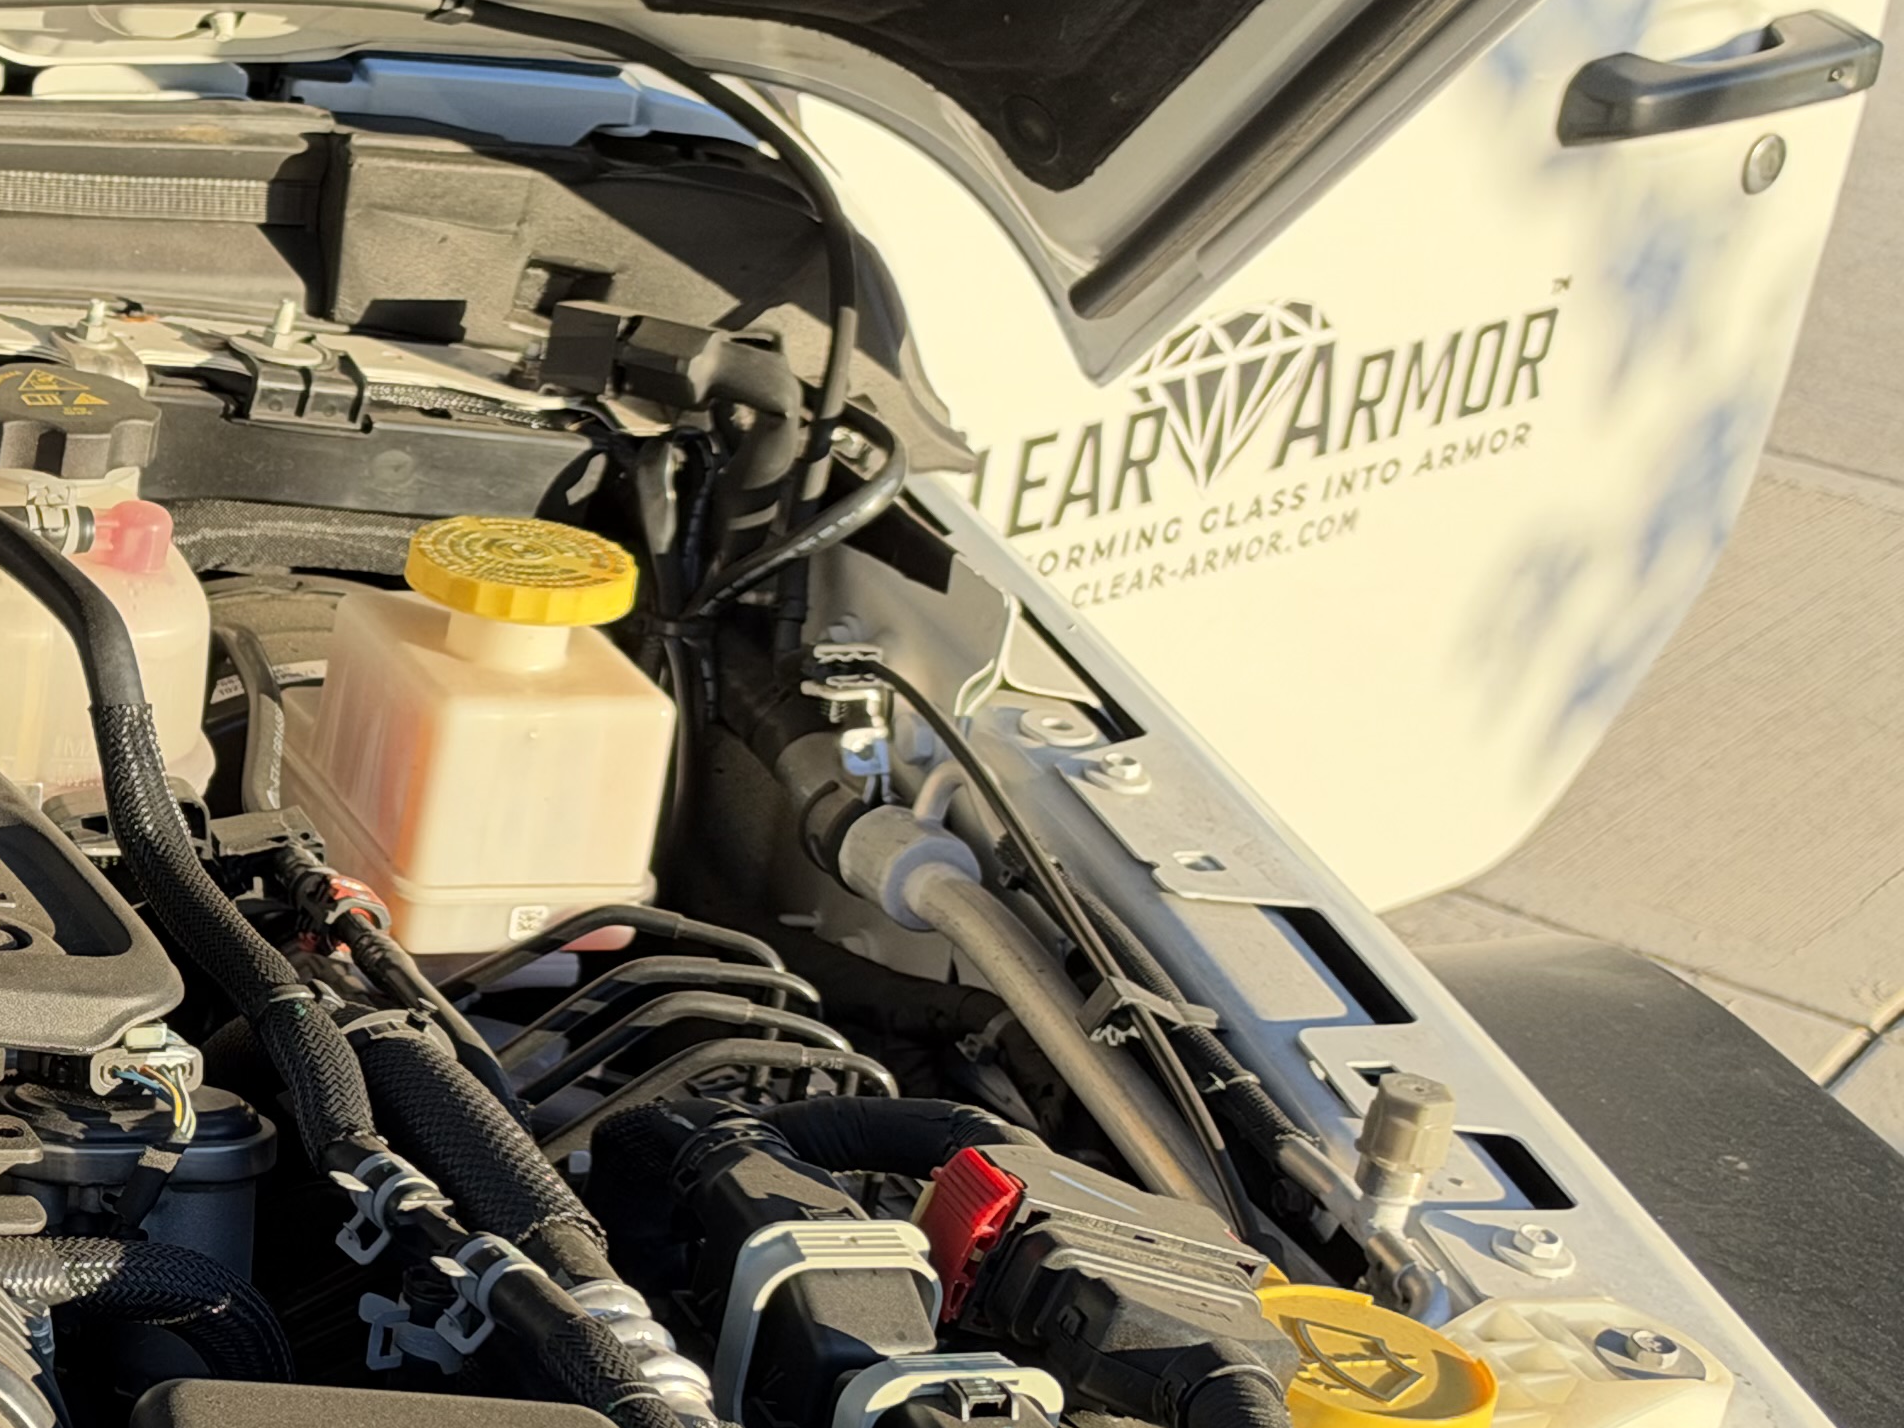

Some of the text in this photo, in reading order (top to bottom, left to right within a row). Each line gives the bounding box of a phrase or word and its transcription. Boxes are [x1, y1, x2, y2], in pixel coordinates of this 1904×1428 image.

[1269, 307, 1560, 471] ARMOR
[1026, 422, 1534, 577] ORMING GLASS INTO ARMOR
[1071, 508, 1361, 610] CLEAR-ARMOR.COM
